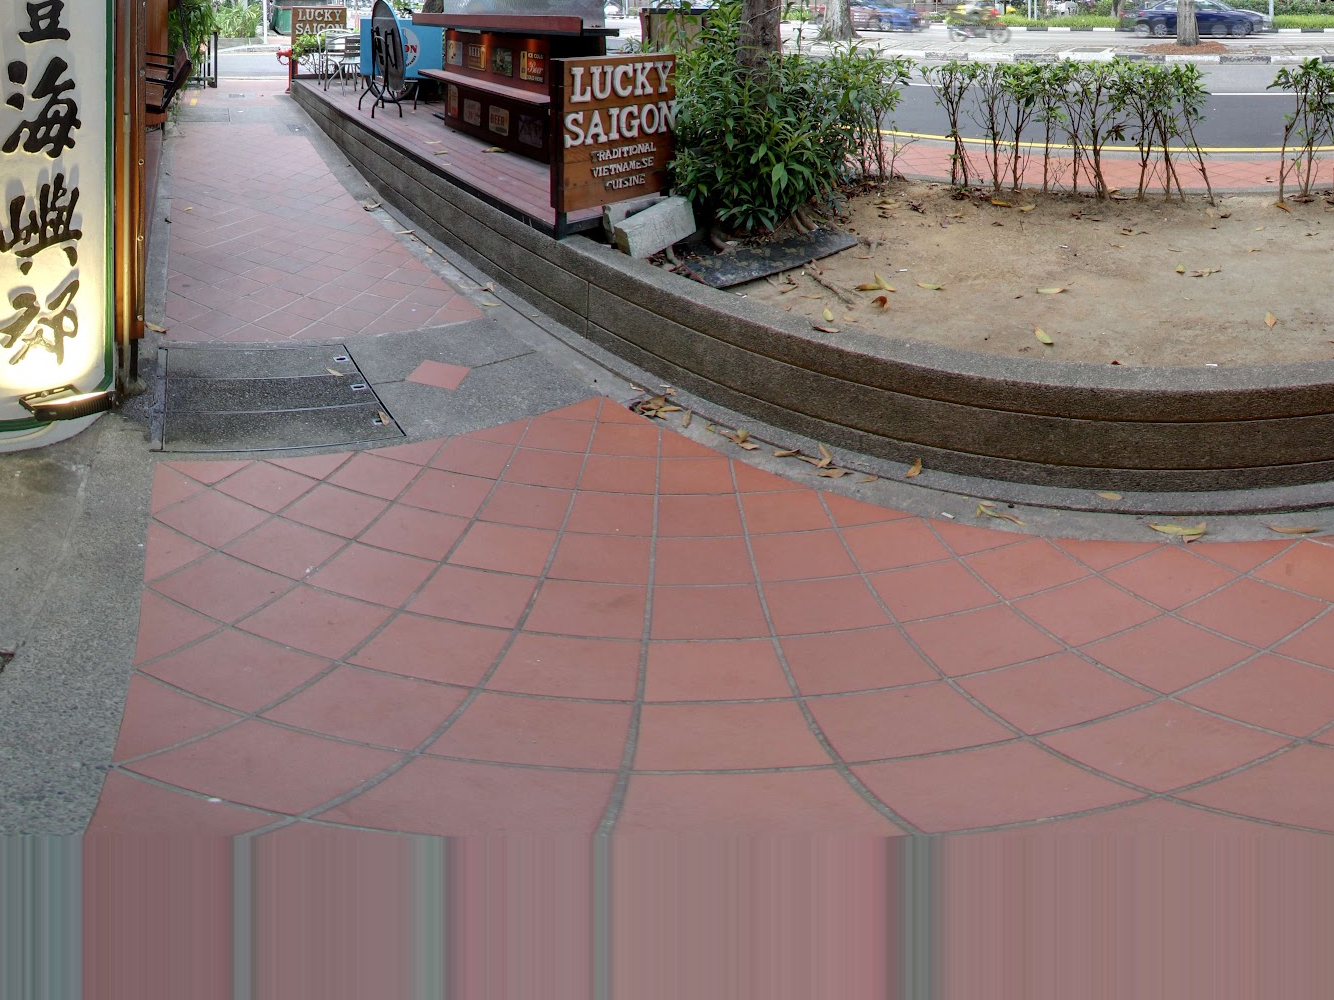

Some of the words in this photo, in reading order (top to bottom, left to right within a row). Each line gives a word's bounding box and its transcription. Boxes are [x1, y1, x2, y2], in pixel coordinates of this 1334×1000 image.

[297, 9, 342, 21] LUCKY
[570, 61, 673, 104] LUCKY
[490, 113, 505, 127] BEER
[564, 100, 678, 149] SAIGON
[591, 142, 657, 162] TRADITIONAL
[591, 156, 654, 178] VIETNAMESE
[605, 173, 646, 191] CUISINE
